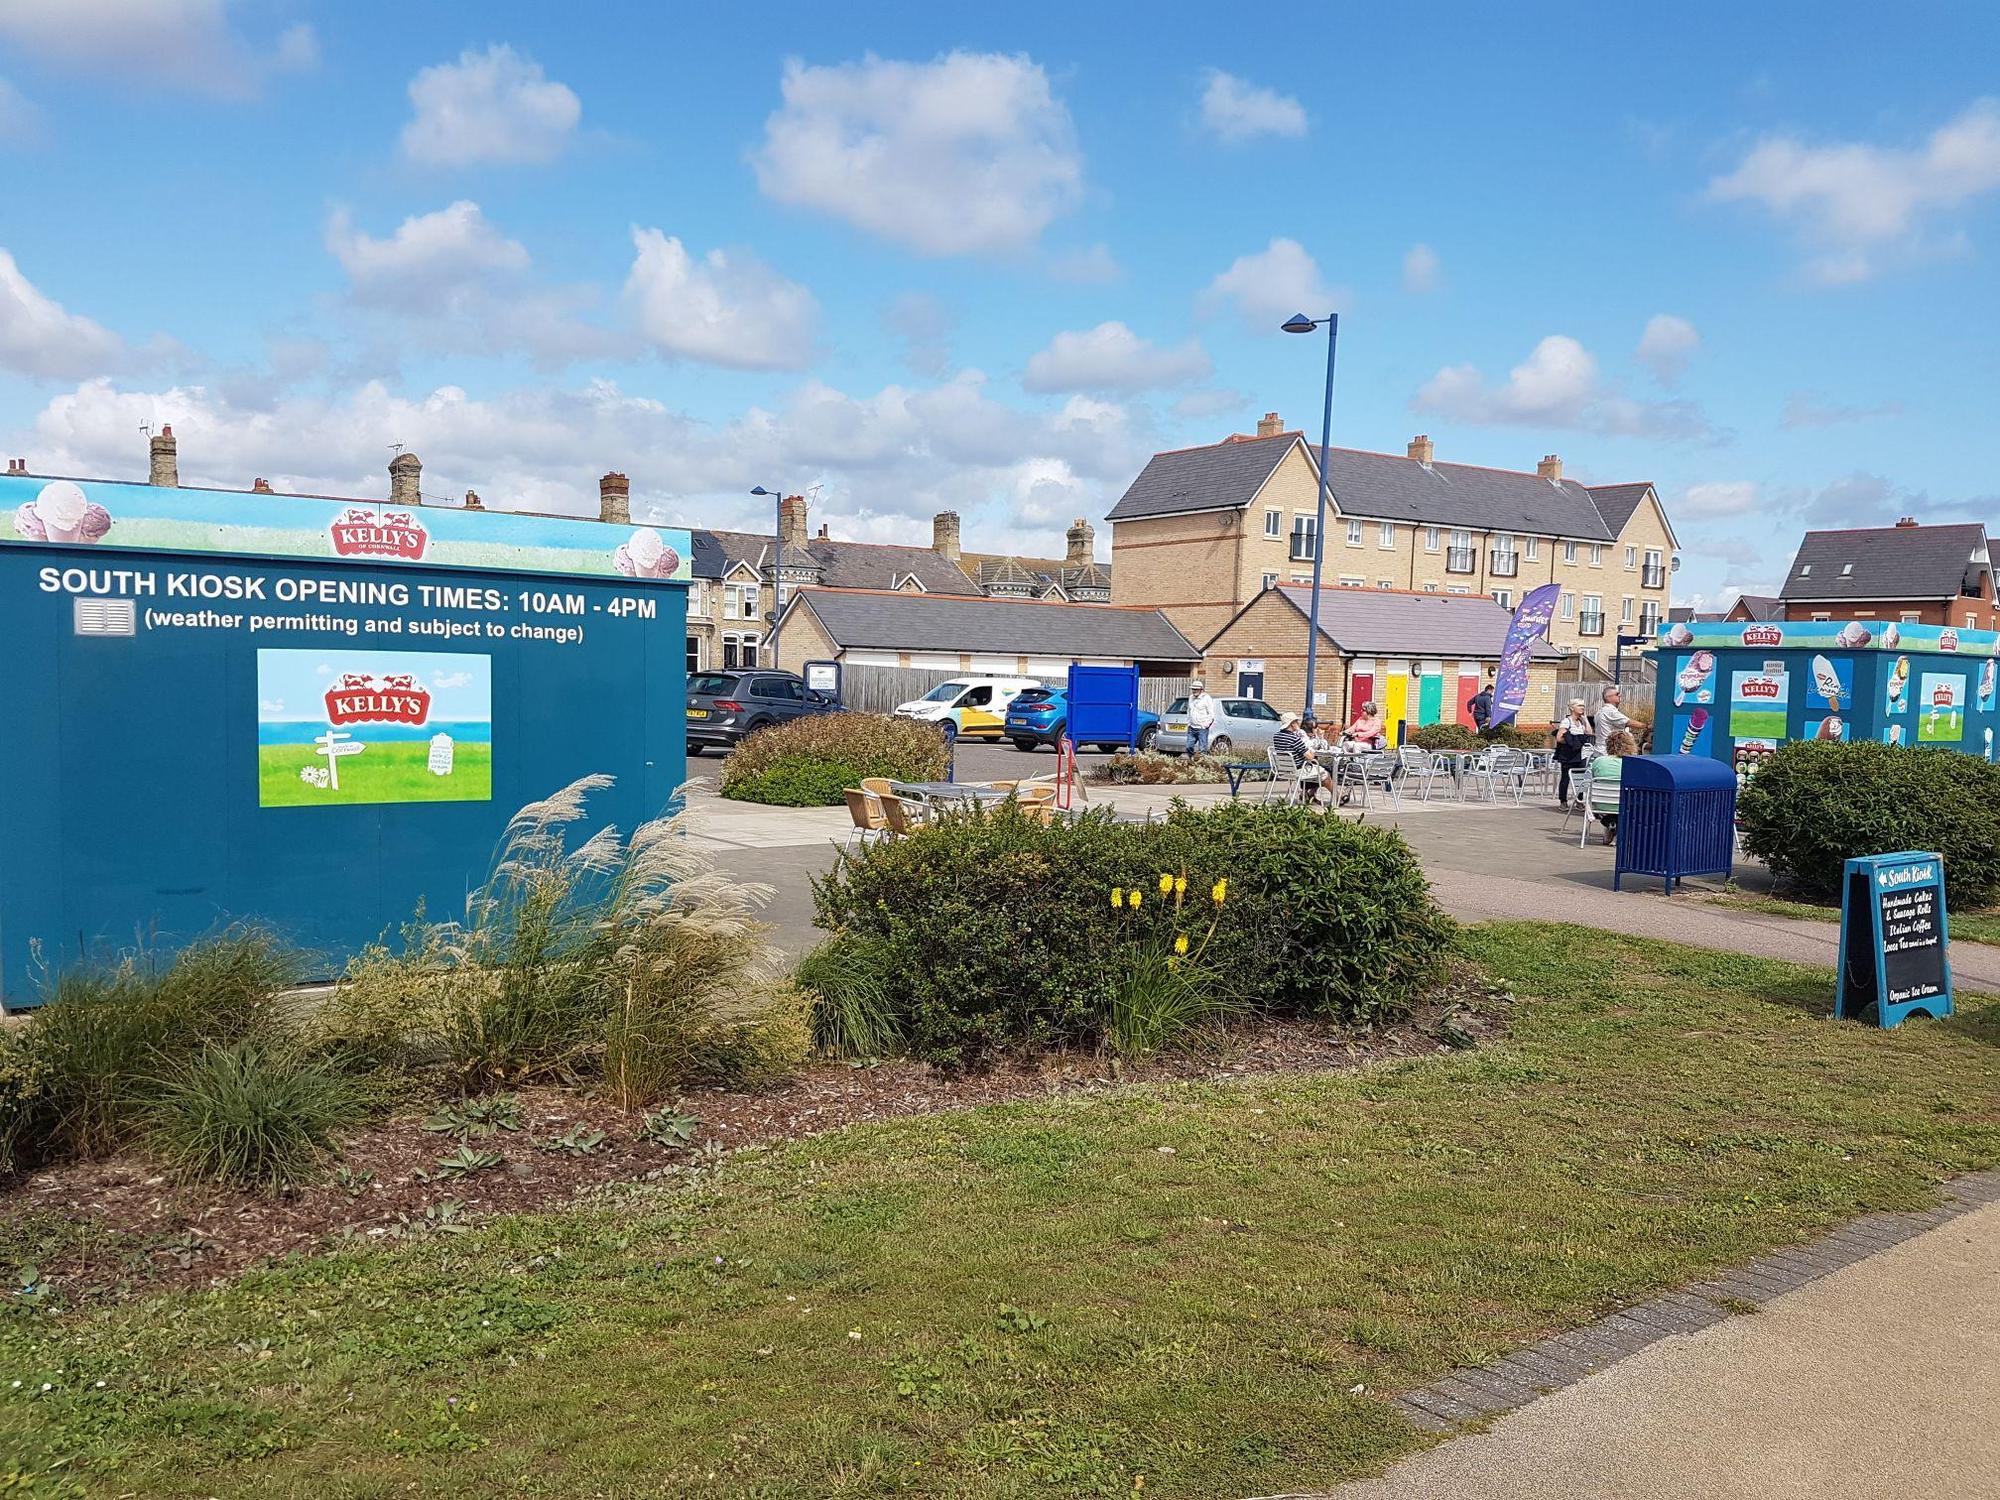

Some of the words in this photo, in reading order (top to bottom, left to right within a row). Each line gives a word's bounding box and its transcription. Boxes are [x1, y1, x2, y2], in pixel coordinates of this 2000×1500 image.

[340, 528, 418, 548] KELLY'S
[39, 567, 155, 596] SOUTH
[167, 573, 266, 599] KIOSK
[275, 578, 409, 606] OPENING
[417, 585, 509, 611] TIMES:
[519, 591, 585, 615] 10AM
[607, 597, 656, 619] 4PM
[145, 607, 243, 629] (weather
[250, 613, 358, 636] permitting
[365, 617, 402, 633] and
[408, 619, 480, 639] subject
[486, 621, 505, 637] to
[511, 623, 584, 644] change)
[1746, 632, 1779, 641] KELLY'S
[1744, 685, 1776, 695] KELLY'S
[334, 695, 421, 715] KELLY'S
[1888, 867, 1911, 887] South
[1911, 864, 1934, 883] Kiosk
[1882, 893, 1912, 909] Handmade
[1914, 890, 1933, 904] Cakes
[1917, 903, 1932, 916] Rolls
[1912, 919, 1932, 934] Coffee
